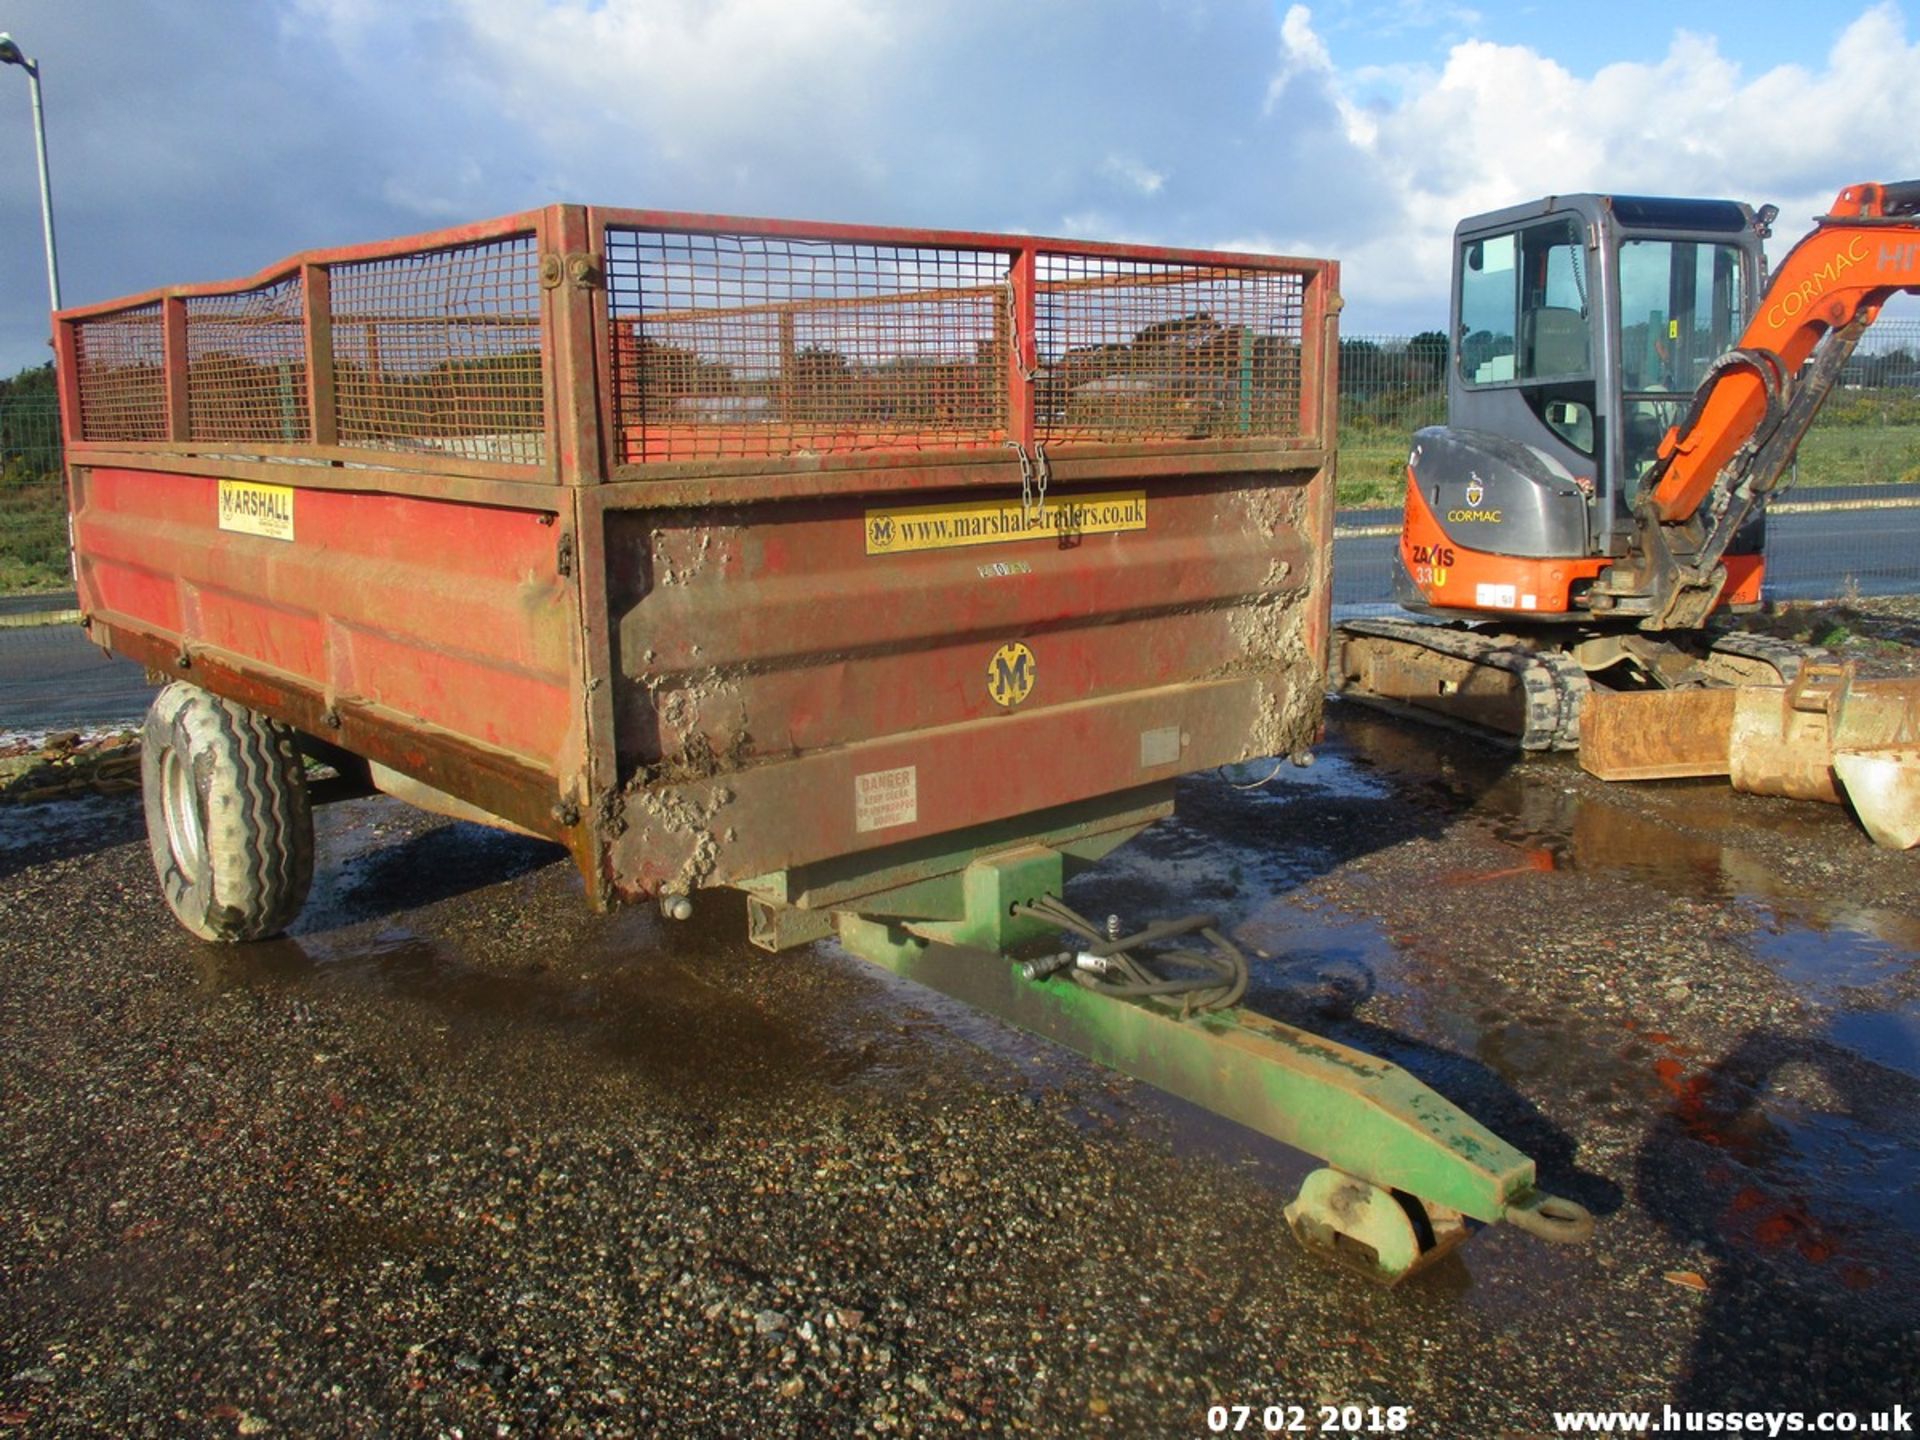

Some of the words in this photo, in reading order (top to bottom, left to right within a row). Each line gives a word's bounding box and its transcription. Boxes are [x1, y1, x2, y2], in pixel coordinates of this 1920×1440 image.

[1767, 235, 1869, 329] CORMAC
[223, 488, 289, 521] MARSHALL
[1447, 510, 1502, 523] CORMAC
[1413, 544, 1454, 567] ZAXIS
[861, 770, 910, 792] DANGER
